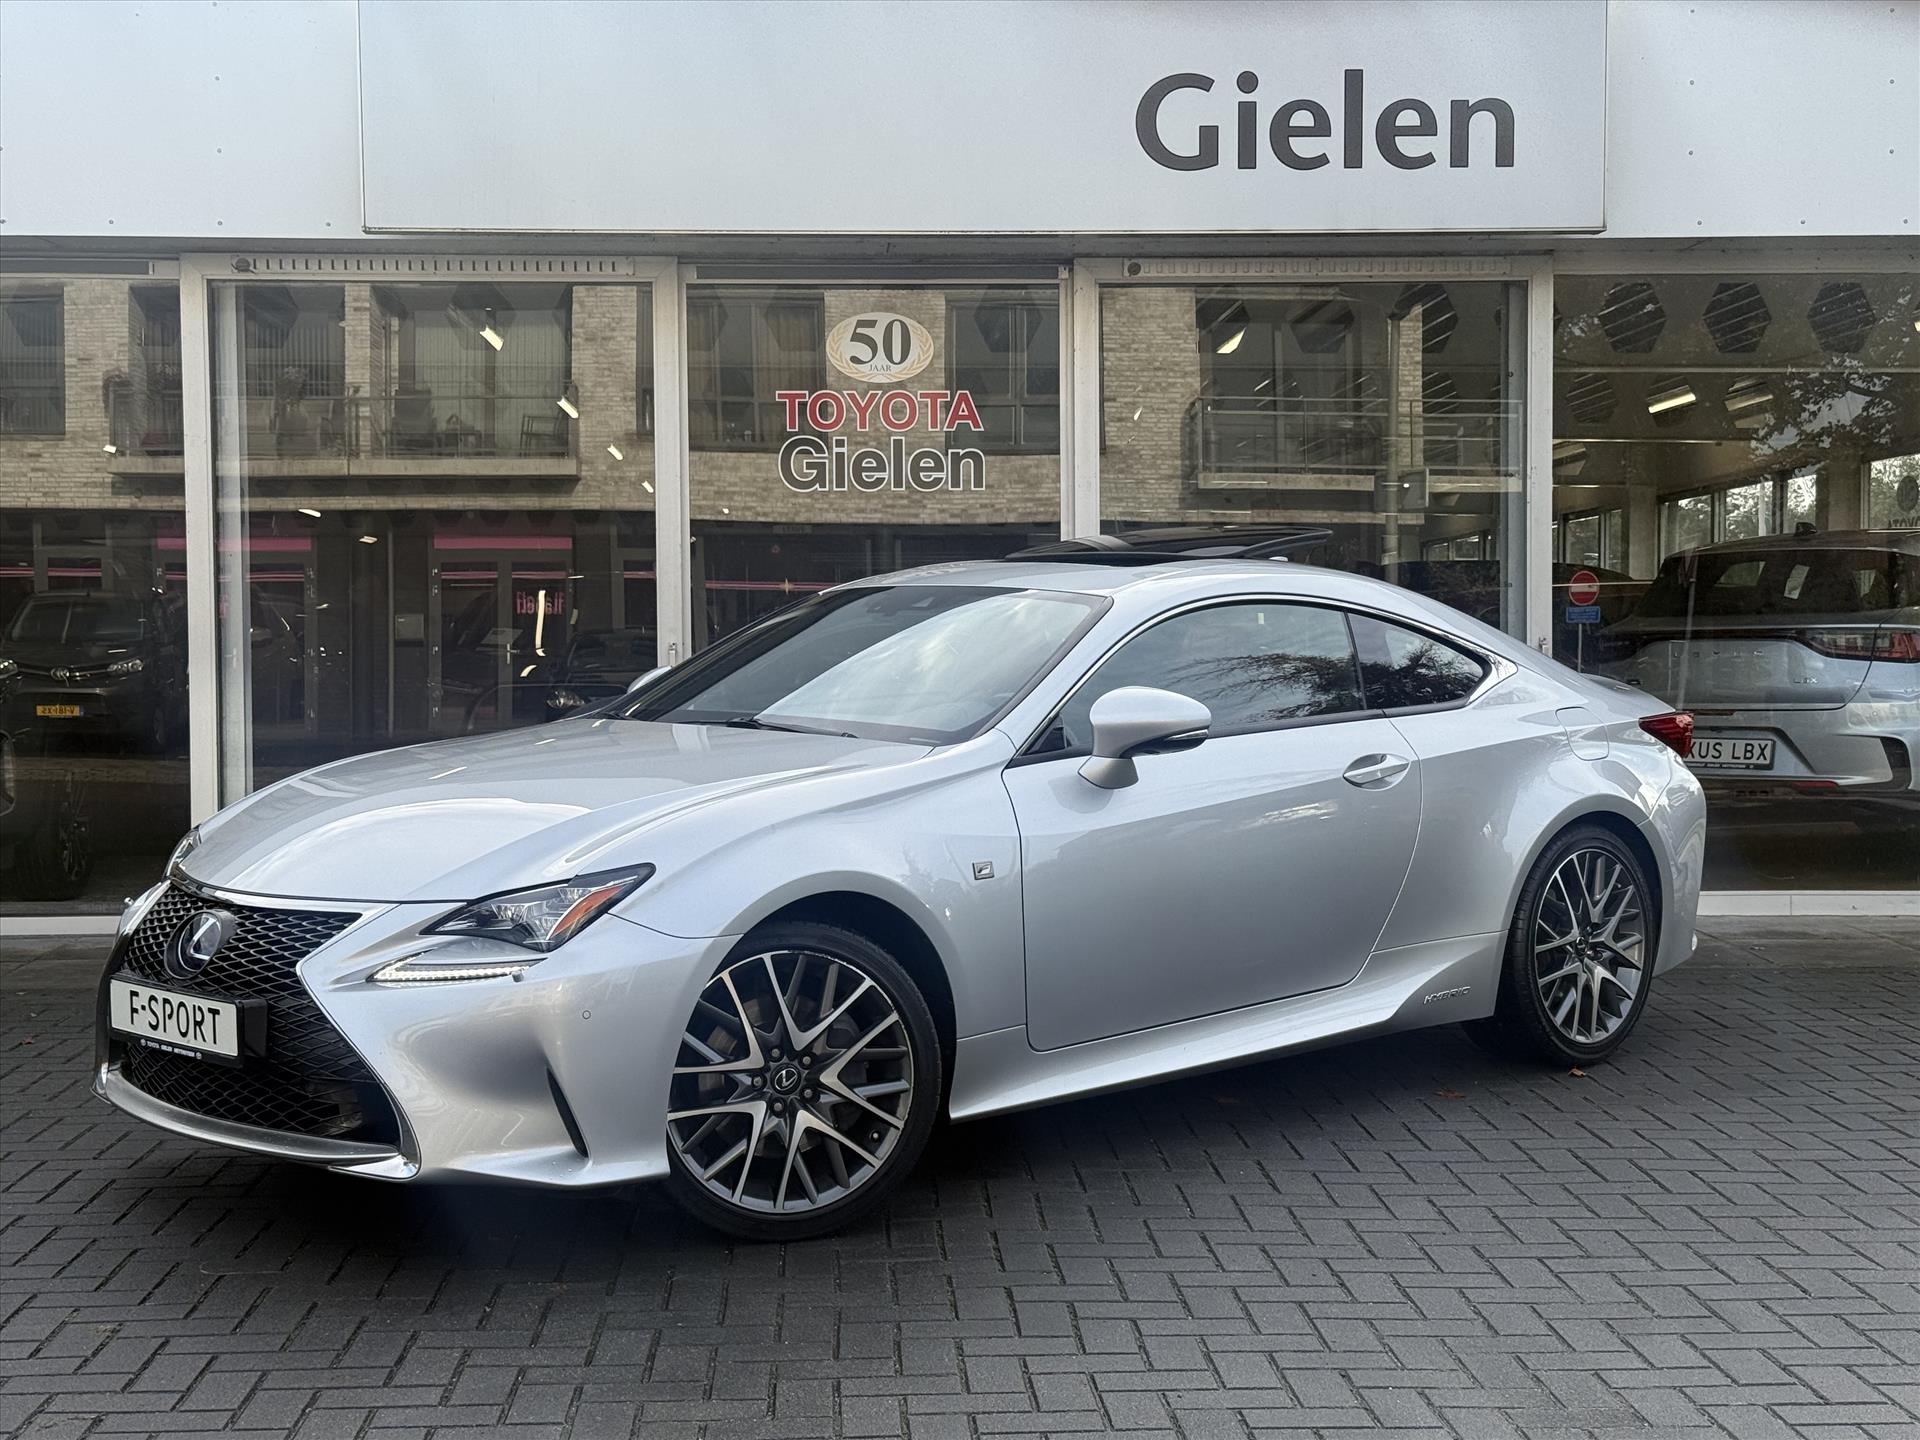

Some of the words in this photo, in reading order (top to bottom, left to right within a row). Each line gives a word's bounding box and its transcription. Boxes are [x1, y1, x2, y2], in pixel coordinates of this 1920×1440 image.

[1135, 68, 1515, 172] Gielen
[850, 318, 912, 365] 50
[868, 364, 892, 373] JAAR
[776, 390, 984, 432] TOYOTA
[778, 435, 986, 493] Gielen
[1686, 741, 1723, 760] XUS
[1731, 742, 1769, 761] LBX
[129, 989, 221, 1046] F-SPORT
